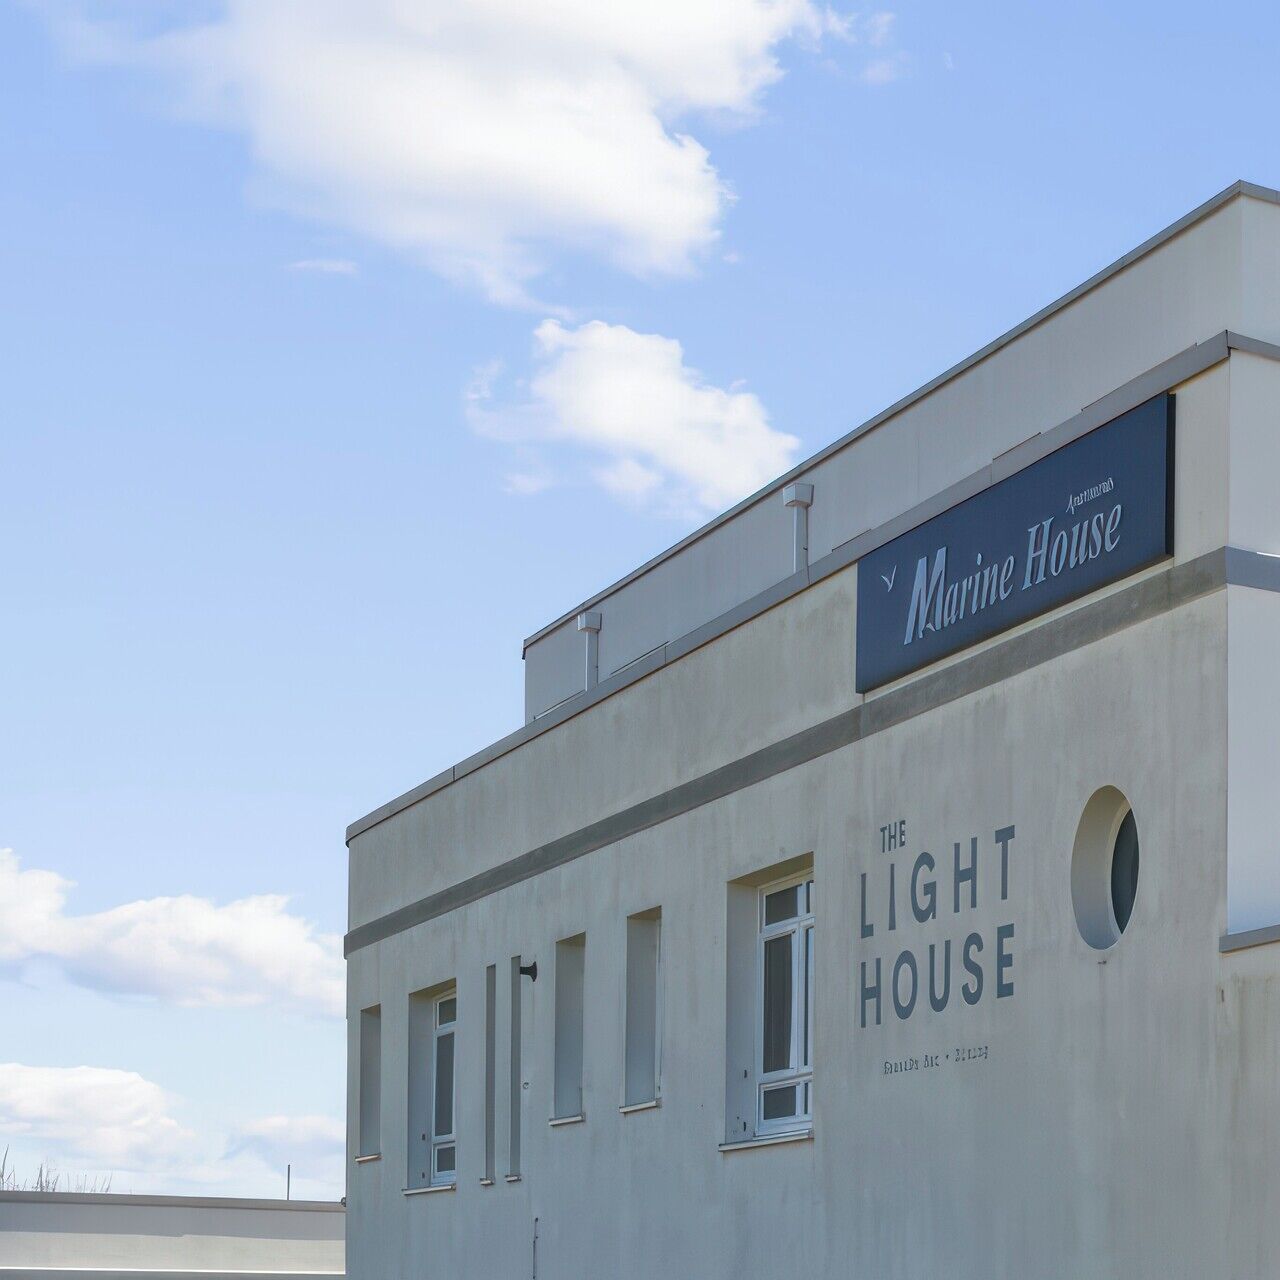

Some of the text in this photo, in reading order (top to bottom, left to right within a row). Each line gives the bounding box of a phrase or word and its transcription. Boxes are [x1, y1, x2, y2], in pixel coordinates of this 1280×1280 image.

[903, 503, 1122, 645] Marine House
[860, 824, 1016, 939] LIGHT
[879, 819, 906, 853] THE
[860, 922, 1015, 1029] HOUSE
